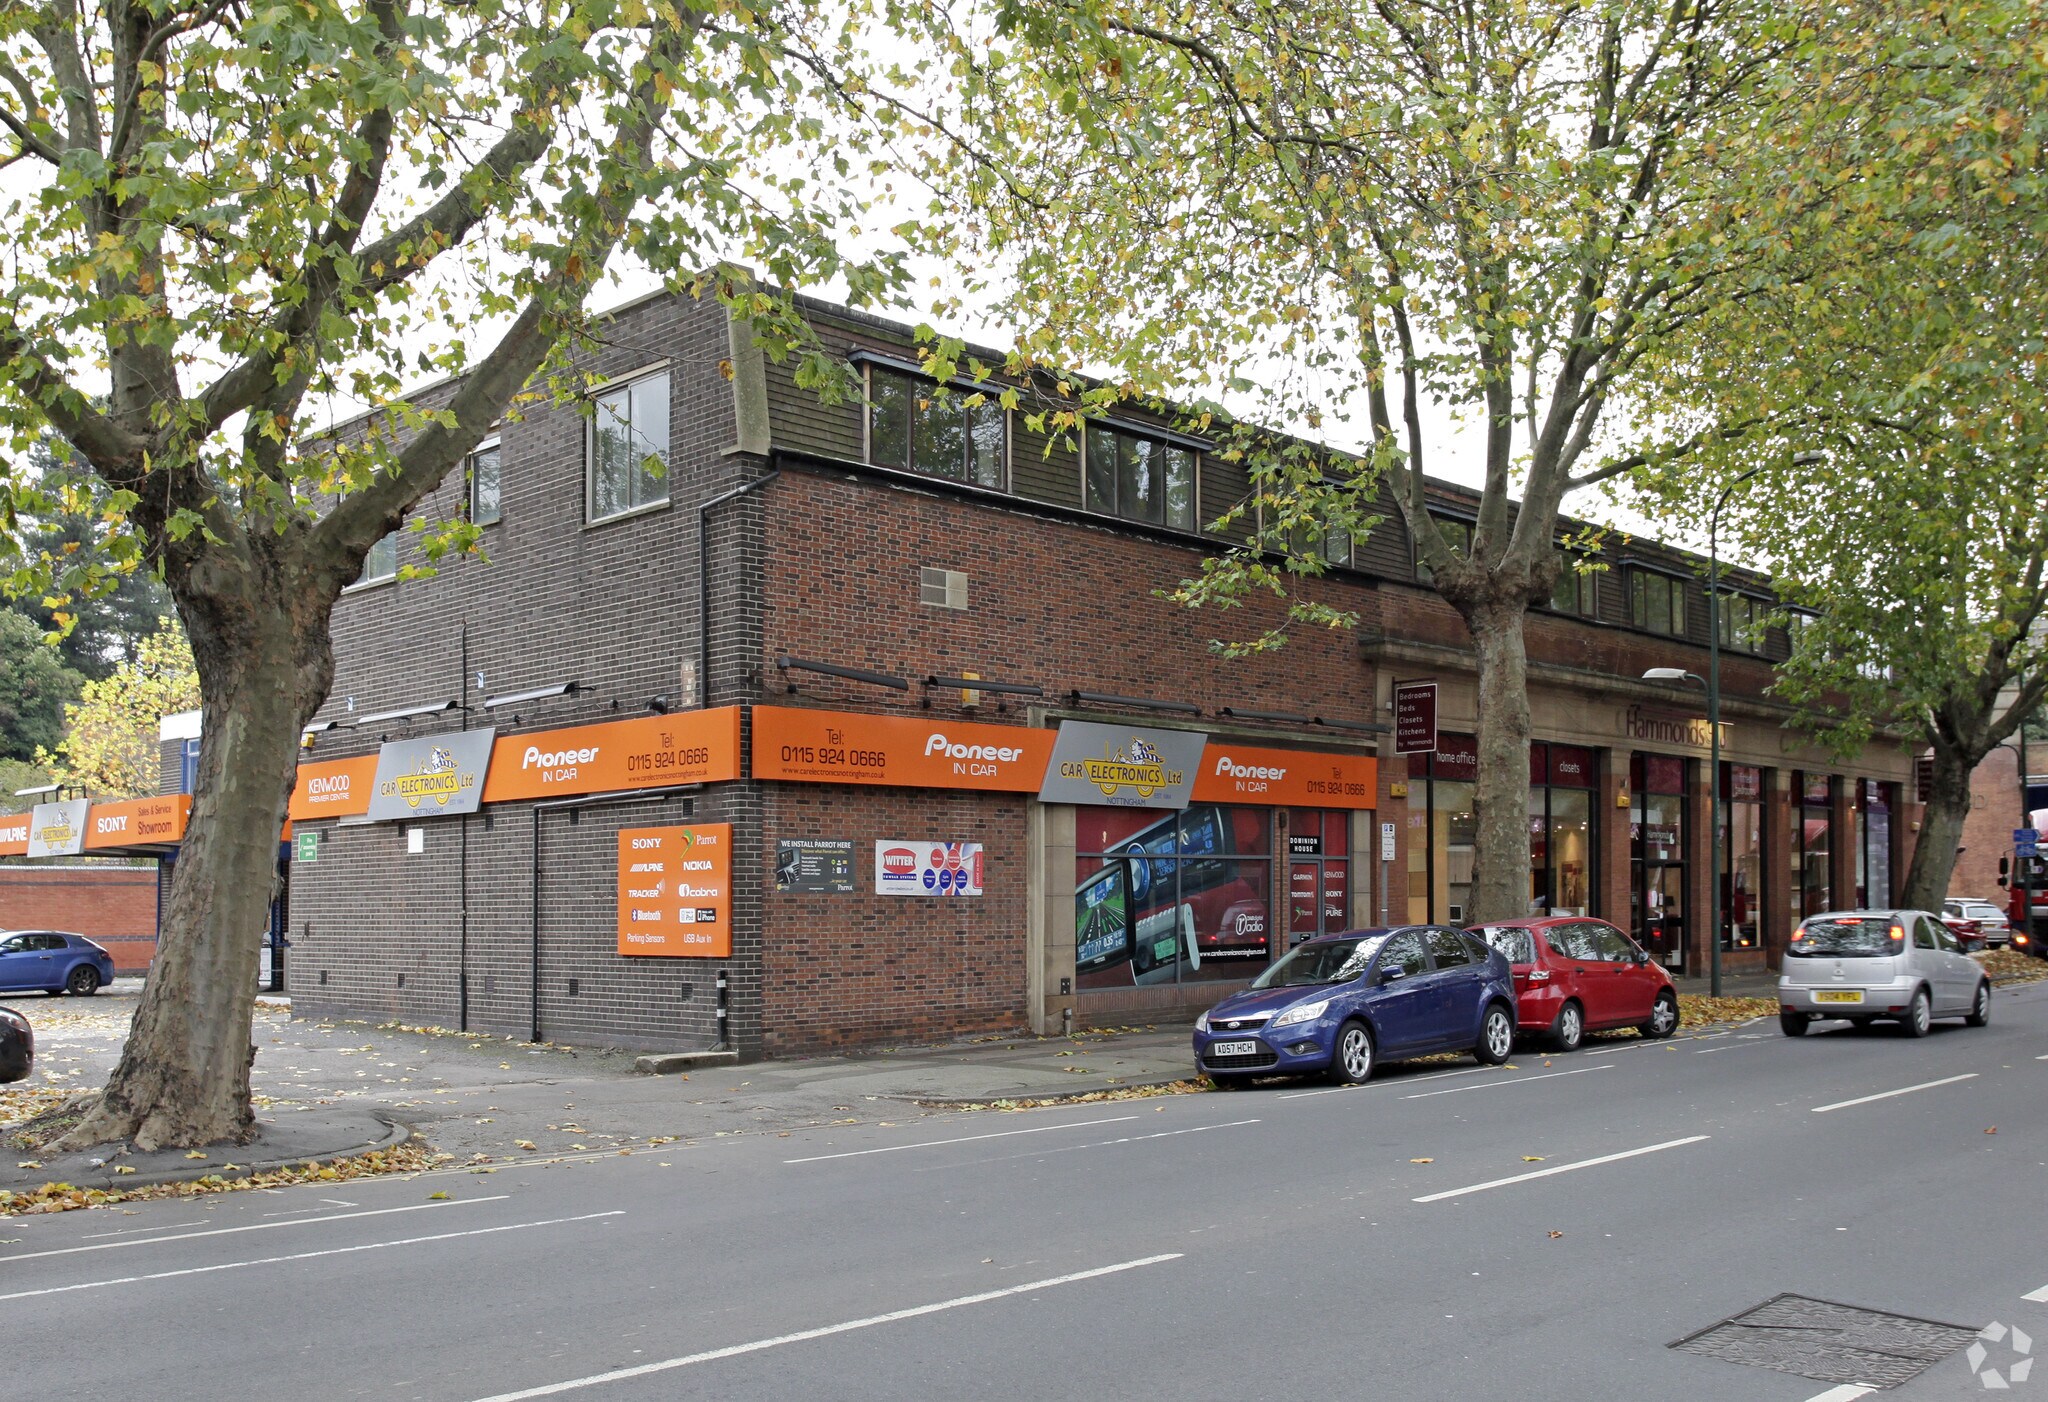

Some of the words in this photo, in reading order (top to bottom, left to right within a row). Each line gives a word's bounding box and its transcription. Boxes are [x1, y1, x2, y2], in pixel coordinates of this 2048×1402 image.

[1399, 691, 1431, 700] Bedrooms
[1398, 704, 1416, 712] Beds
[1398, 716, 1423, 724] Closets
[1398, 728, 1426, 736] Kitchens
[1626, 708, 1705, 746] Hammonds
[660, 733, 675, 749] Tel:
[826, 728, 845, 745] Tel:
[925, 733, 1023, 763] Pioneer
[522, 746, 600, 770] Pioneer
[627, 754, 652, 771] 0115
[655, 751, 675, 769] 924
[679, 747, 709, 765] 0666
[781, 745, 814, 763] 0115
[819, 747, 846, 765] 924
[850, 750, 886, 768] 0666
[1437, 750, 1455, 764] home
[1455, 751, 1476, 765] office
[953, 762, 966, 775] IN
[971, 763, 997, 777] CAR
[1060, 762, 1083, 778] CAR
[1091, 764, 1160, 784] ELECTRONICS
[1168, 770, 1182, 784] Ltd
[1215, 756, 1287, 780] Pioneer
[1559, 760, 1580, 774] closets
[542, 771, 553, 783] IN
[555, 768, 577, 782] CAR
[308, 774, 350, 795] KENWOOD
[380, 781, 396, 797] CAR
[401, 774, 455, 794] ELECTRONICS
[461, 773, 474, 788] Ltd
[1235, 780, 1245, 792] IN
[1248, 781, 1268, 793] CAR
[1307, 780, 1325, 794] 0115
[1327, 781, 1343, 795] 924
[1344, 783, 1365, 796] 0666
[1106, 797, 1146, 806] NOTTINGHAM
[138, 806, 150, 817] Sales
[155, 804, 172, 815] Service
[413, 807, 444, 817] NOTTINGHAM
[97, 815, 128, 834] SONY
[138, 820, 173, 836] Showroom
[632, 838, 662, 849] SONY
[696, 834, 717, 846] Parrot
[791, 840, 814, 848] INSTALL
[814, 840, 836, 849] PARROT
[837, 841, 852, 849] HERE
[1289, 837, 1318, 845] DOMINION
[683, 860, 713, 871] NOKIA
[885, 855, 914, 867] WITTER
[628, 889, 659, 898] TRACKER
[690, 887, 718, 897] cobra
[1325, 890, 1343, 898] SONY
[637, 909, 662, 921] Bluetooth
[1325, 909, 1343, 917] PURE
[627, 933, 645, 945] Parking
[645, 933, 665, 943] Sensors
[684, 933, 695, 943] USB
[696, 933, 706, 943] Aux
[1217, 1044, 1235, 1054] AD57
[1237, 1042, 1253, 1053] HCH
